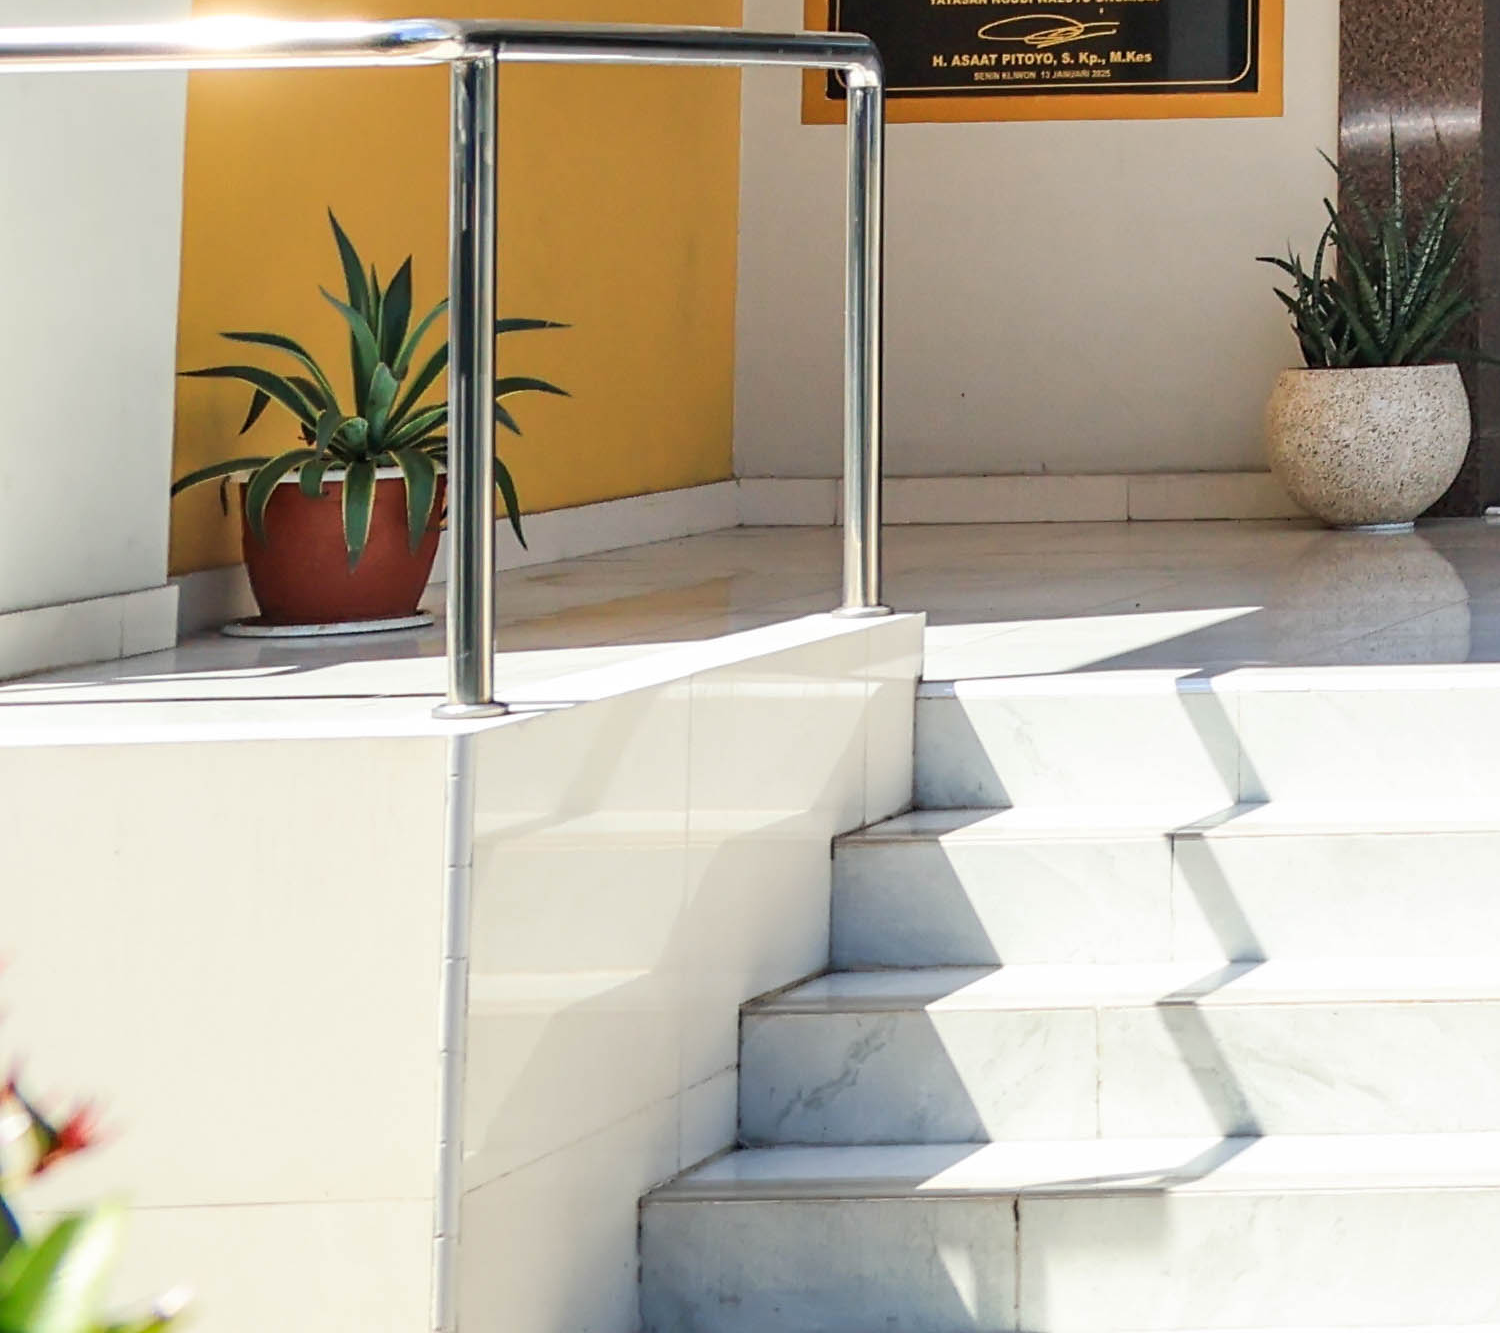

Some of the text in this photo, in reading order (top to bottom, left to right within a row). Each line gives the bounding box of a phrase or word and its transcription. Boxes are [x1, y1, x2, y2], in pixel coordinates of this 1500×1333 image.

[932, 56, 948, 67] H.
[951, 54, 998, 67] ASAAT
[1002, 53, 1058, 66] PITOYO,
[1061, 53, 1075, 65] S.
[1110, 51, 1153, 63] M.Kes
[974, 71, 1000, 81] SENIN
[1040, 71, 1050, 79] 13
[1052, 70, 1090, 79] JANUARI
